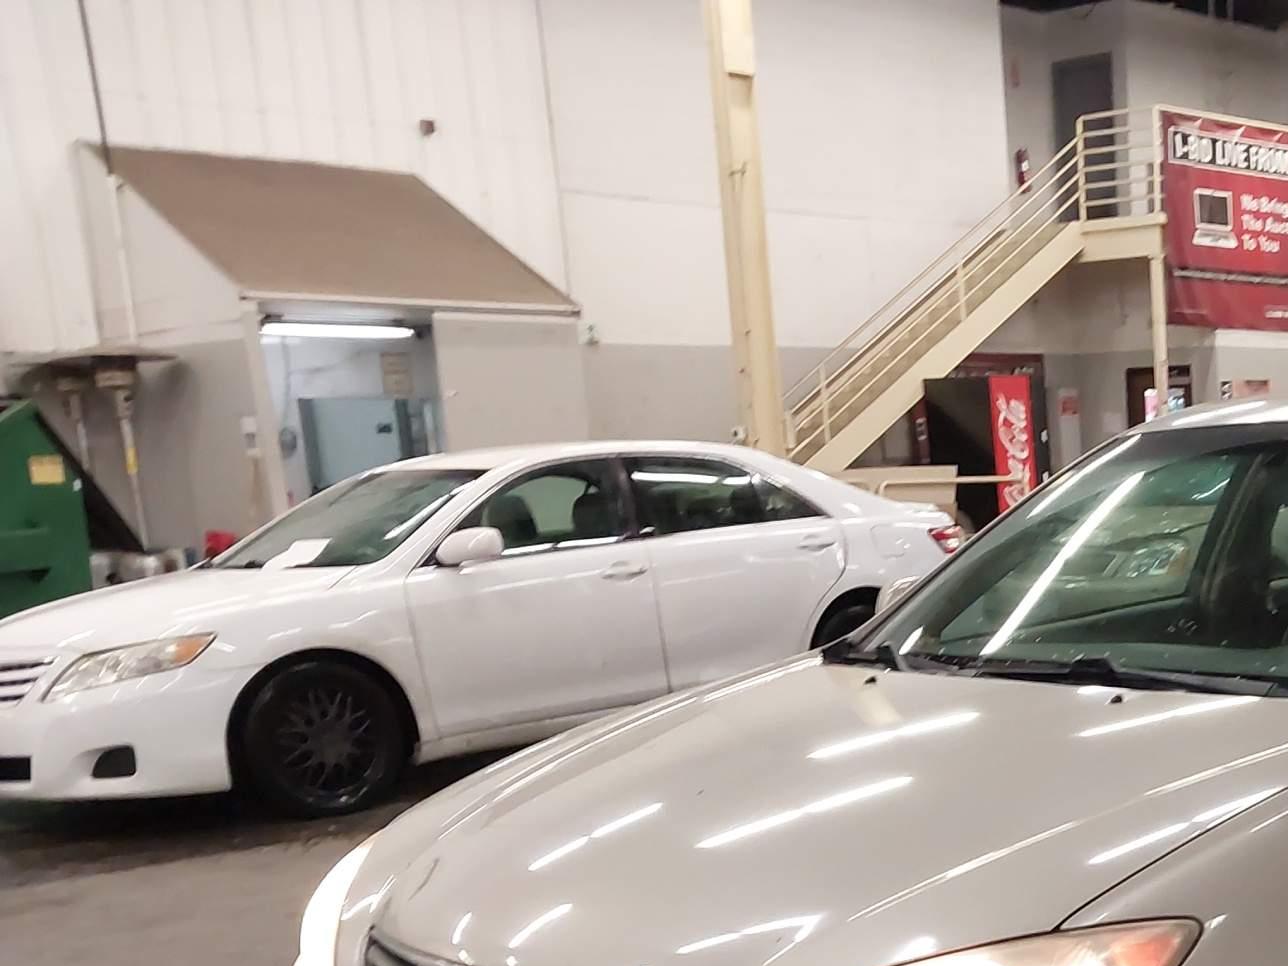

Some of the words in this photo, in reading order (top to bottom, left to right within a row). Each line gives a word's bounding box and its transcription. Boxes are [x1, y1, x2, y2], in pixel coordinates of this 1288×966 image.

[1215, 139, 1248, 168] LIVE
[1240, 192, 1259, 212] We
[1241, 213, 1263, 232] The
[1241, 233, 1257, 251] To
[1257, 234, 1280, 253] You
